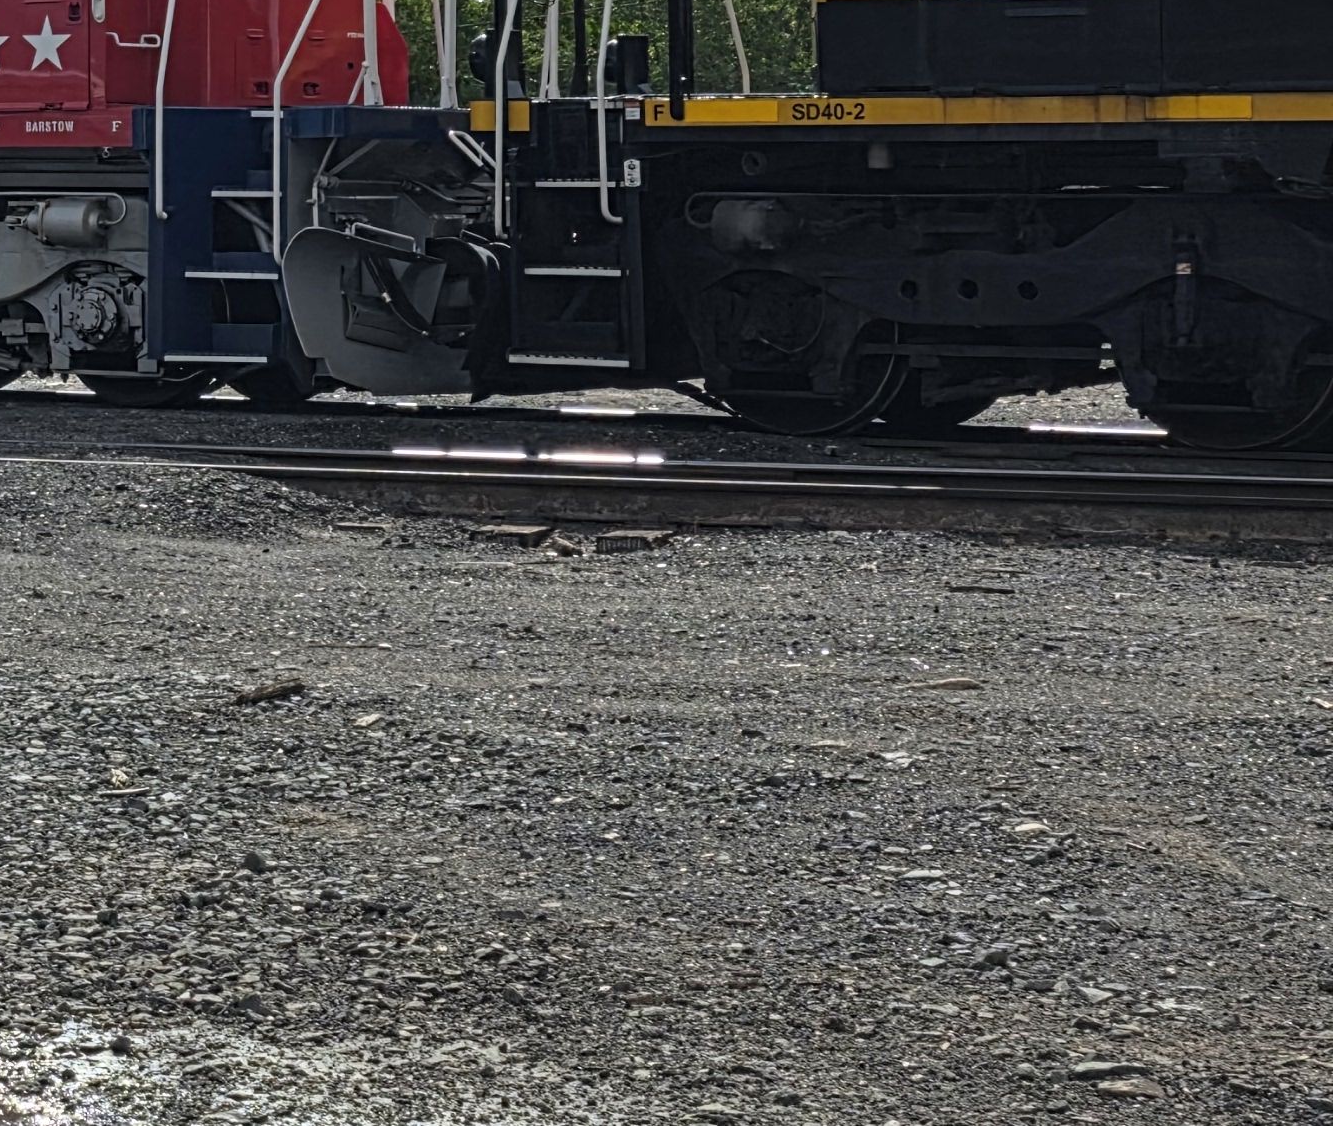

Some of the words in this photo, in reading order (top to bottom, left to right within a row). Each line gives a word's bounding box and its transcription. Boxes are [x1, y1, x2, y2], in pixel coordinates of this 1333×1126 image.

[653, 104, 665, 121] F
[792, 103, 865, 121] SD40-2
[25, 121, 74, 132] BARSTOW
[111, 120, 122, 132] F
